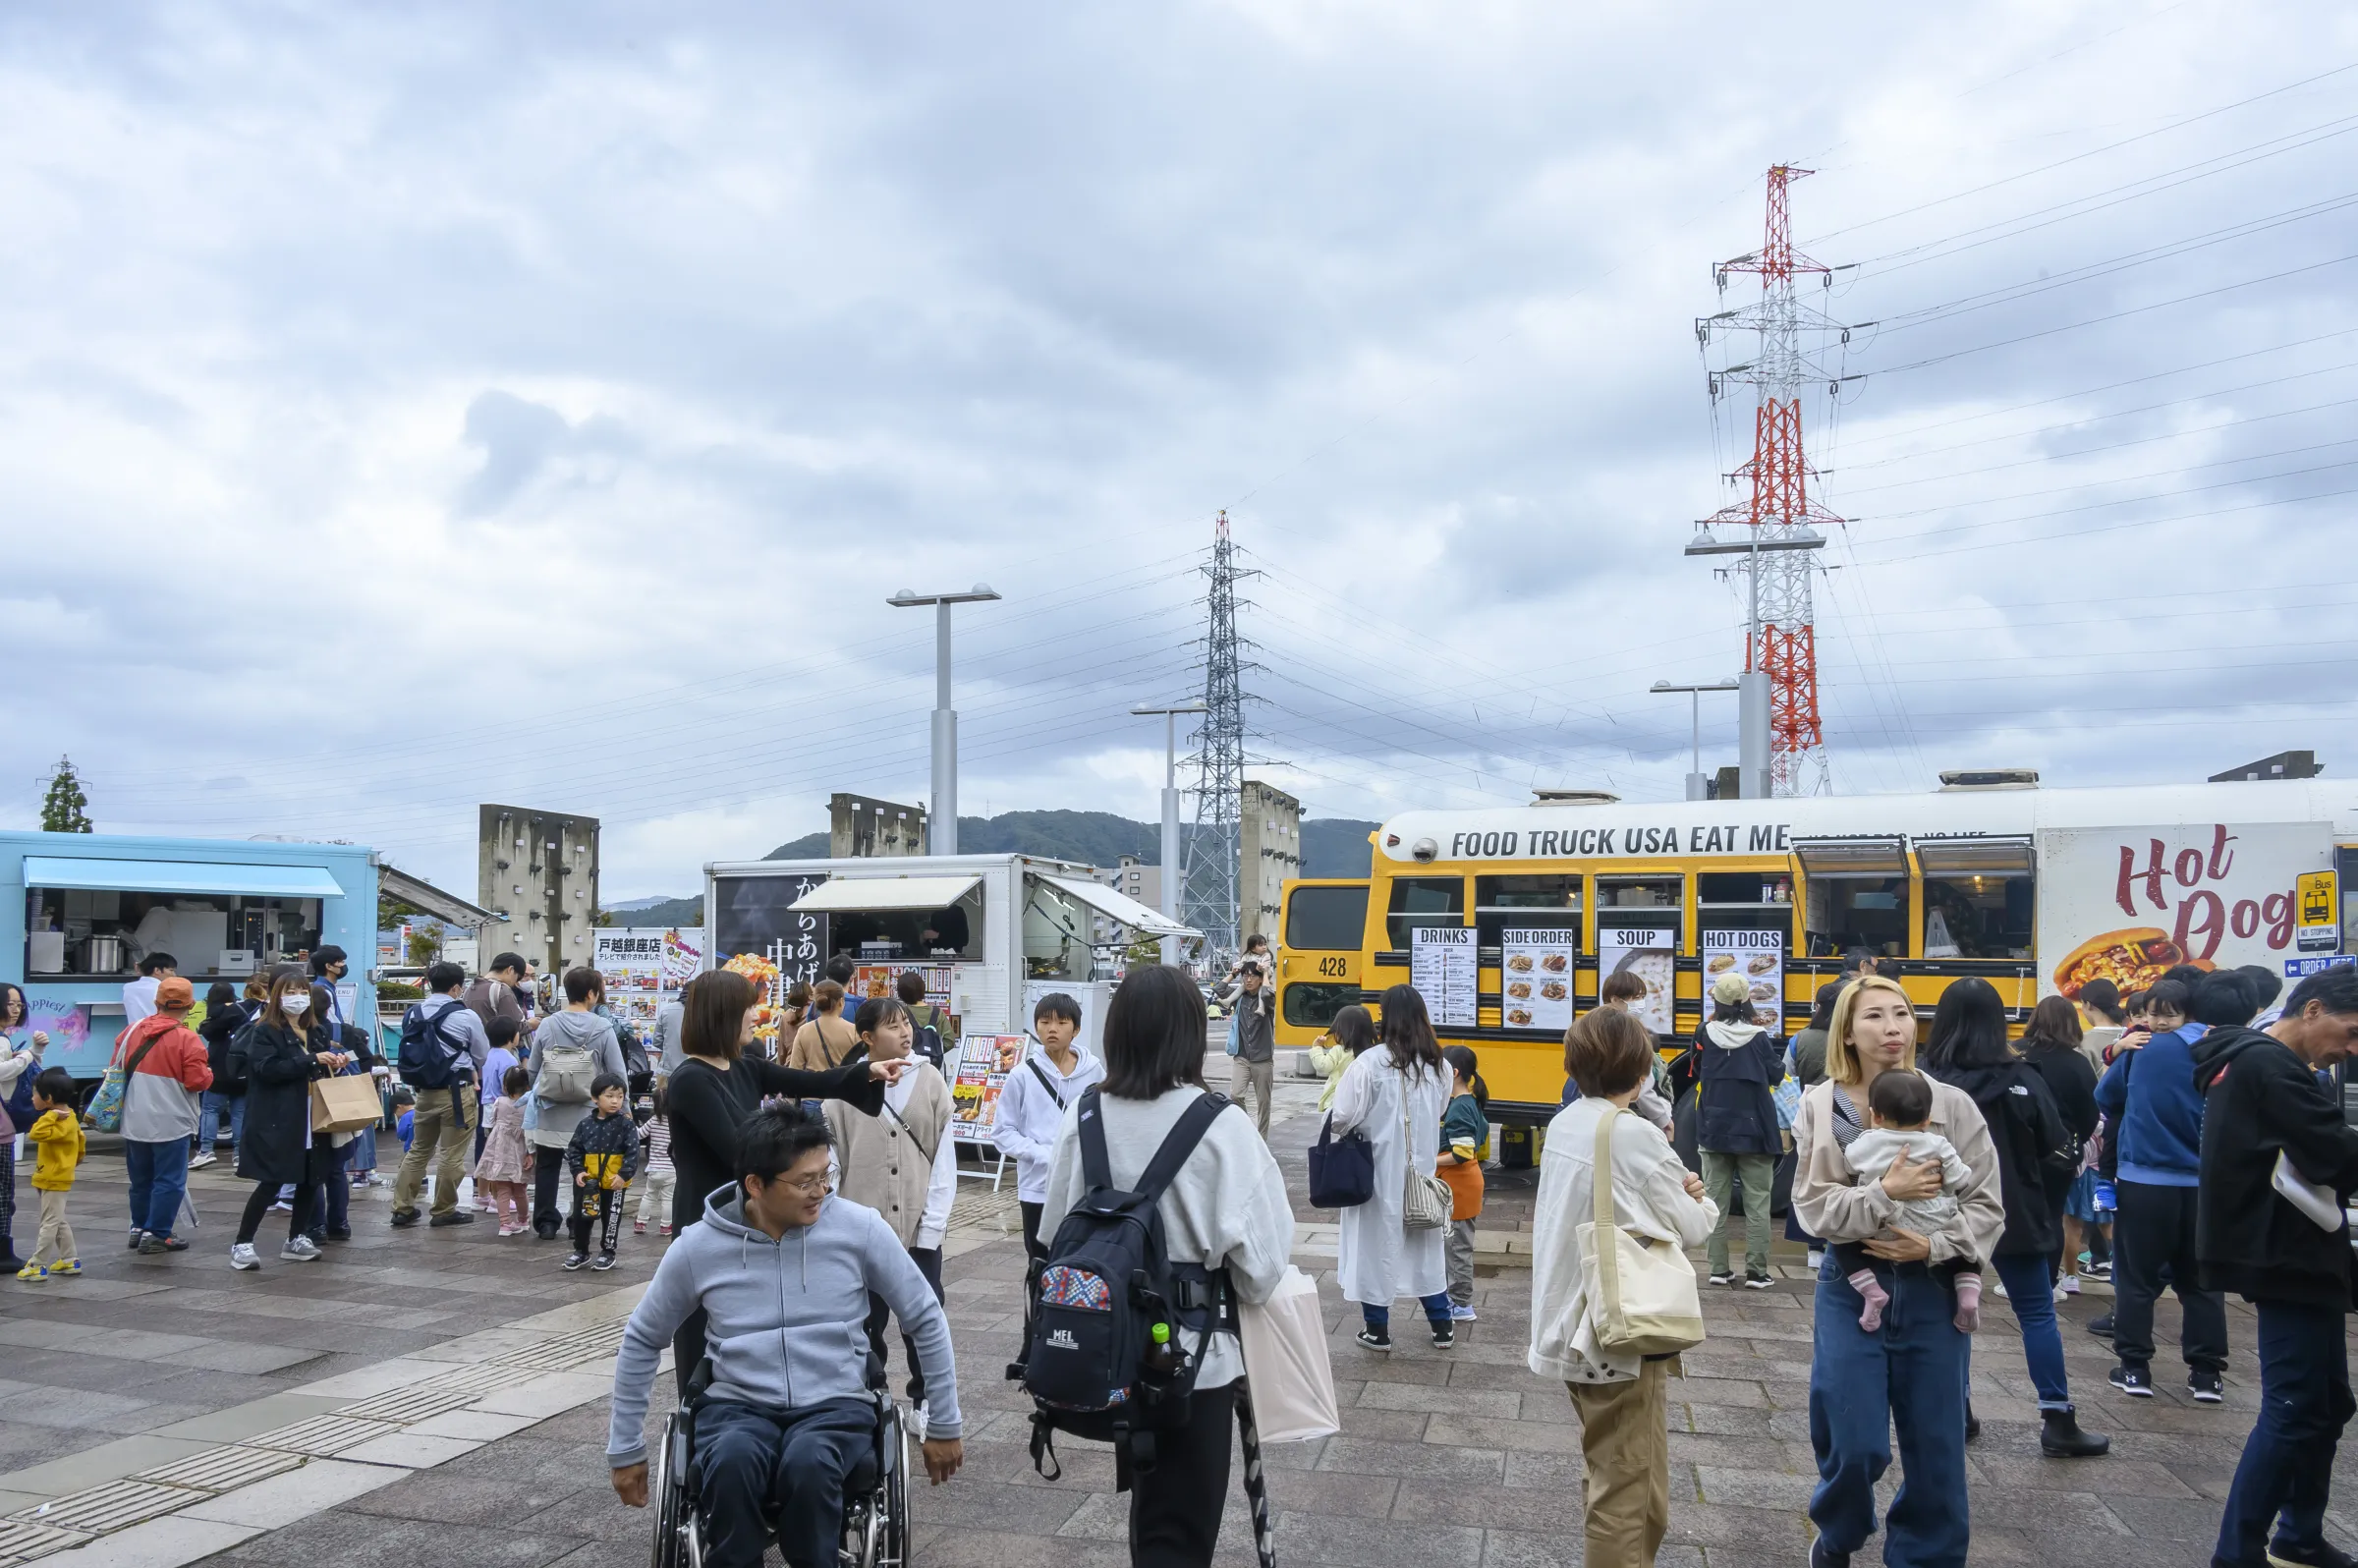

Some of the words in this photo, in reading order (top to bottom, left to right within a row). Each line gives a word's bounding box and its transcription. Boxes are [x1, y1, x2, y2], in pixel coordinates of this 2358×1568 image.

[1451, 831, 1518, 857] FOOD
[1528, 828, 1616, 856] TRUCK
[1624, 827, 1679, 854] USA
[1690, 825, 1740, 853] EAT
[1749, 824, 1790, 852] ME
[2115, 823, 2239, 917] Hot
[2315, 879, 2332, 889] Bus
[2172, 889, 2295, 964] Dog
[2310, 927, 2333, 936] STOPPING
[1421, 928, 1468, 944] DRINKS
[1503, 930, 1530, 944] SIDE
[1532, 930, 1572, 944] ORDER
[1617, 930, 1656, 946] SOUP
[1706, 931, 1736, 947] HOT
[1738, 931, 1780, 947] DOGS
[598, 938, 661, 953] 戸越銀座店
[1319, 957, 1346, 978] 428
